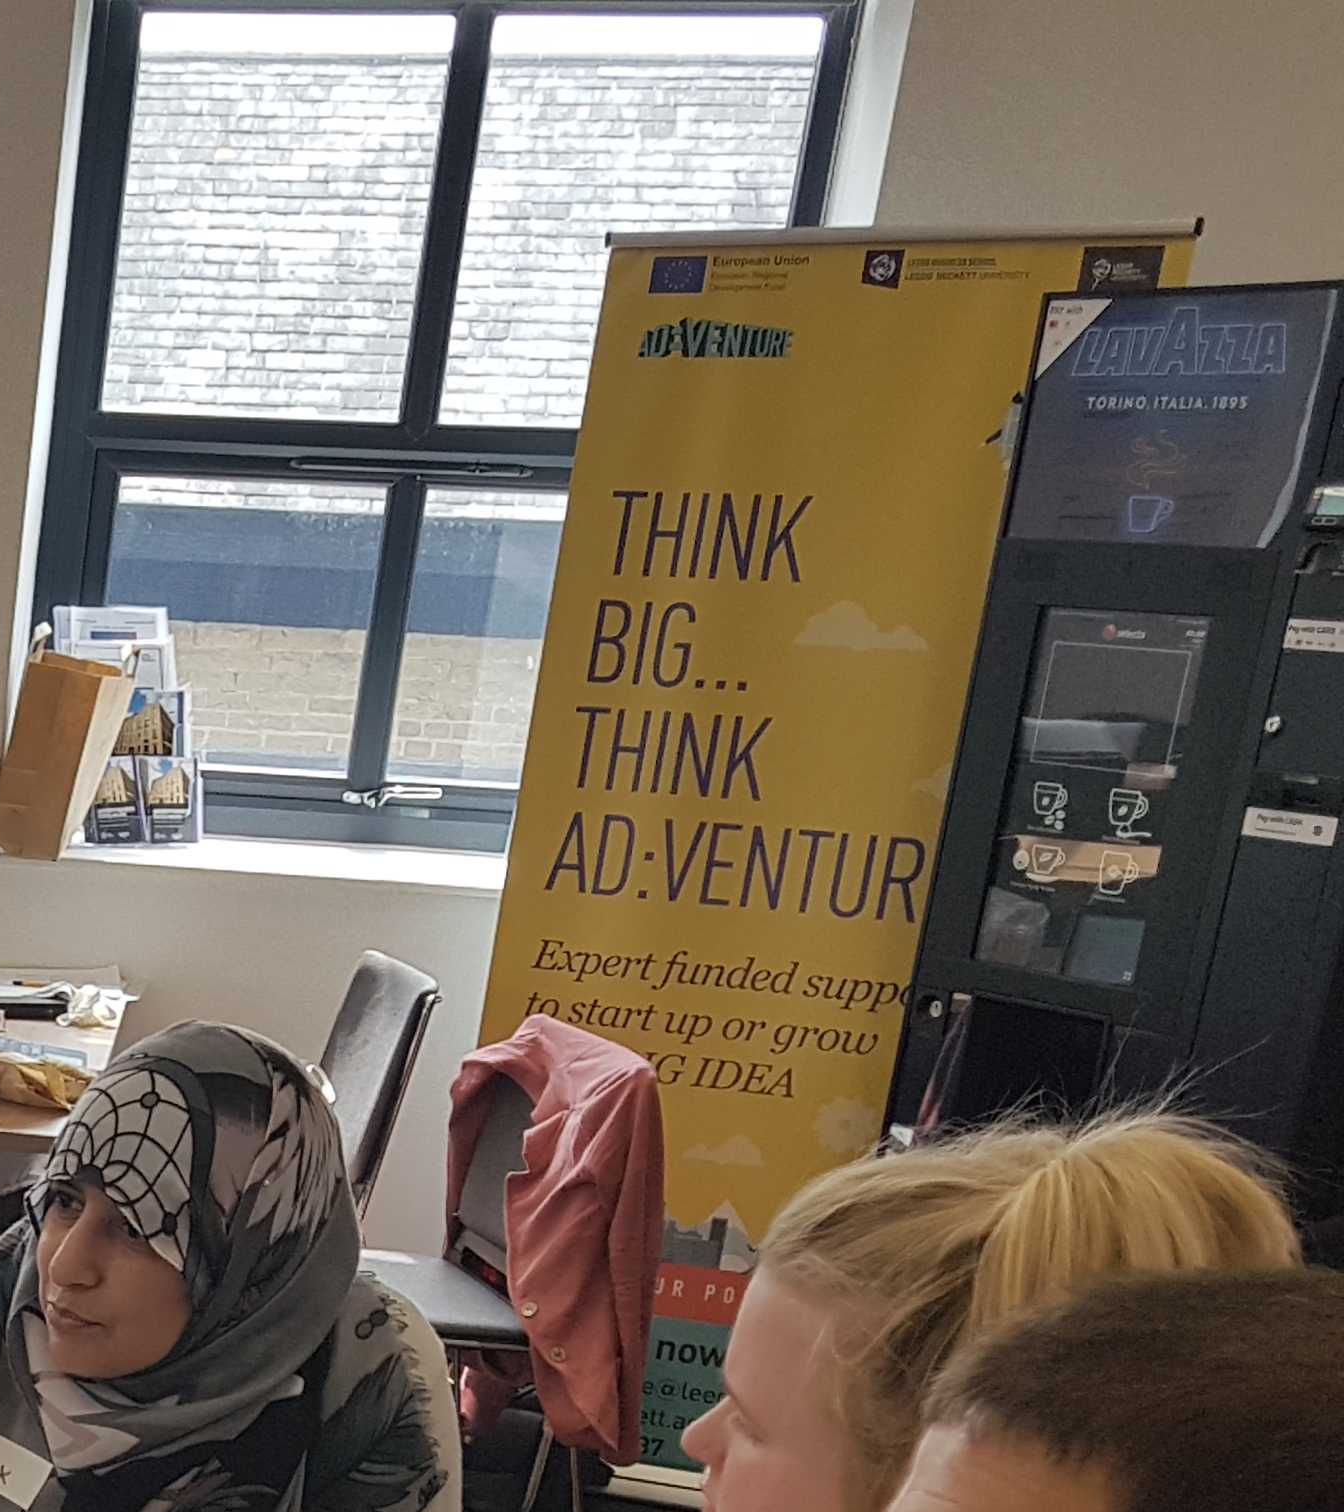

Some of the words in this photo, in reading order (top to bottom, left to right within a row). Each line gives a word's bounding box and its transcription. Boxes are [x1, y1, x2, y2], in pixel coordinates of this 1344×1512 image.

[712, 256, 770, 267] European
[774, 255, 810, 266] Union
[1072, 307, 1286, 376] LAVAZZA
[1213, 396, 1249, 409] 1895
[613, 490, 814, 584] THINK
[586, 600, 748, 693] BIG...
[574, 706, 774, 802] THINK
[530, 938, 656, 982] Expert
[653, 950, 799, 995] funded
[567, 996, 658, 1032] start
[665, 1010, 713, 1046] up
[722, 1016, 765, 1042] or
[770, 1023, 880, 1056] grow
[691, 1056, 796, 1098] IDEA
